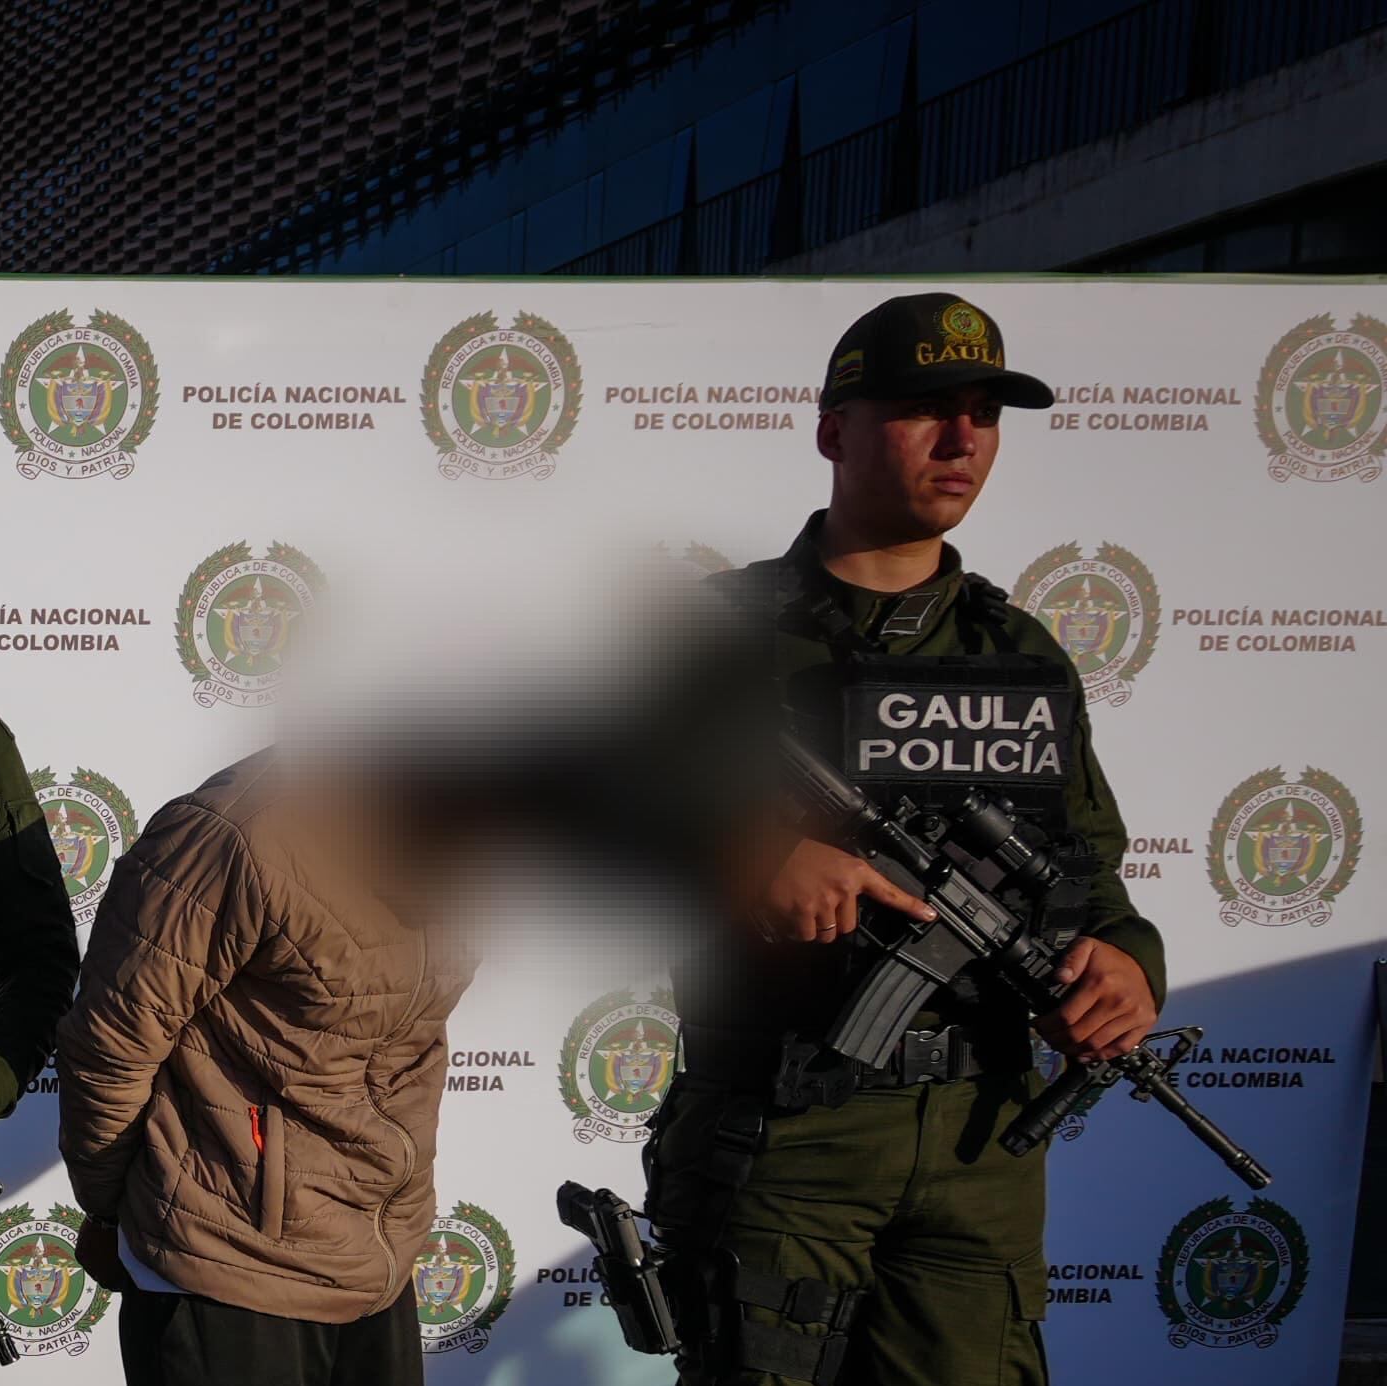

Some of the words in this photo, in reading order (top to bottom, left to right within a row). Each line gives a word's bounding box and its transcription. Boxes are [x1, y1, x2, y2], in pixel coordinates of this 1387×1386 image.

[183, 383, 276, 403] POLICÍA
[286, 387, 406, 403] NACIONAL
[606, 383, 698, 403] POLICÍA
[1055, 382, 1114, 404] LICÍA
[1123, 388, 1241, 405] NACIONAL
[213, 413, 242, 429] DE
[251, 413, 374, 429] COLOMBIA
[635, 414, 664, 429] DE
[673, 413, 793, 429] COLOMBIA
[1051, 414, 1079, 430] DE
[1088, 414, 1208, 431] COLOMBIA
[31, 609, 150, 625] NACIONAL
[1173, 607, 1263, 625] POLICÍA
[1271, 610, 1387, 626] NACIONAL
[1200, 635, 1229, 651] DE
[1237, 635, 1355, 651] COLOMBIA
[877, 692, 1055, 731] GAULA
[858, 731, 1062, 775] POLICÍA
[1126, 838, 1192, 854] IONAL
[452, 1051, 535, 1067] CIONAL
[1221, 1048, 1335, 1063] NACIONAL
[1187, 1072, 1303, 1088] COLOMBIA
[536, 1268, 605, 1284] POLIC
[1046, 1265, 1143, 1279] ACIONAL
[563, 1292, 592, 1307] DE
